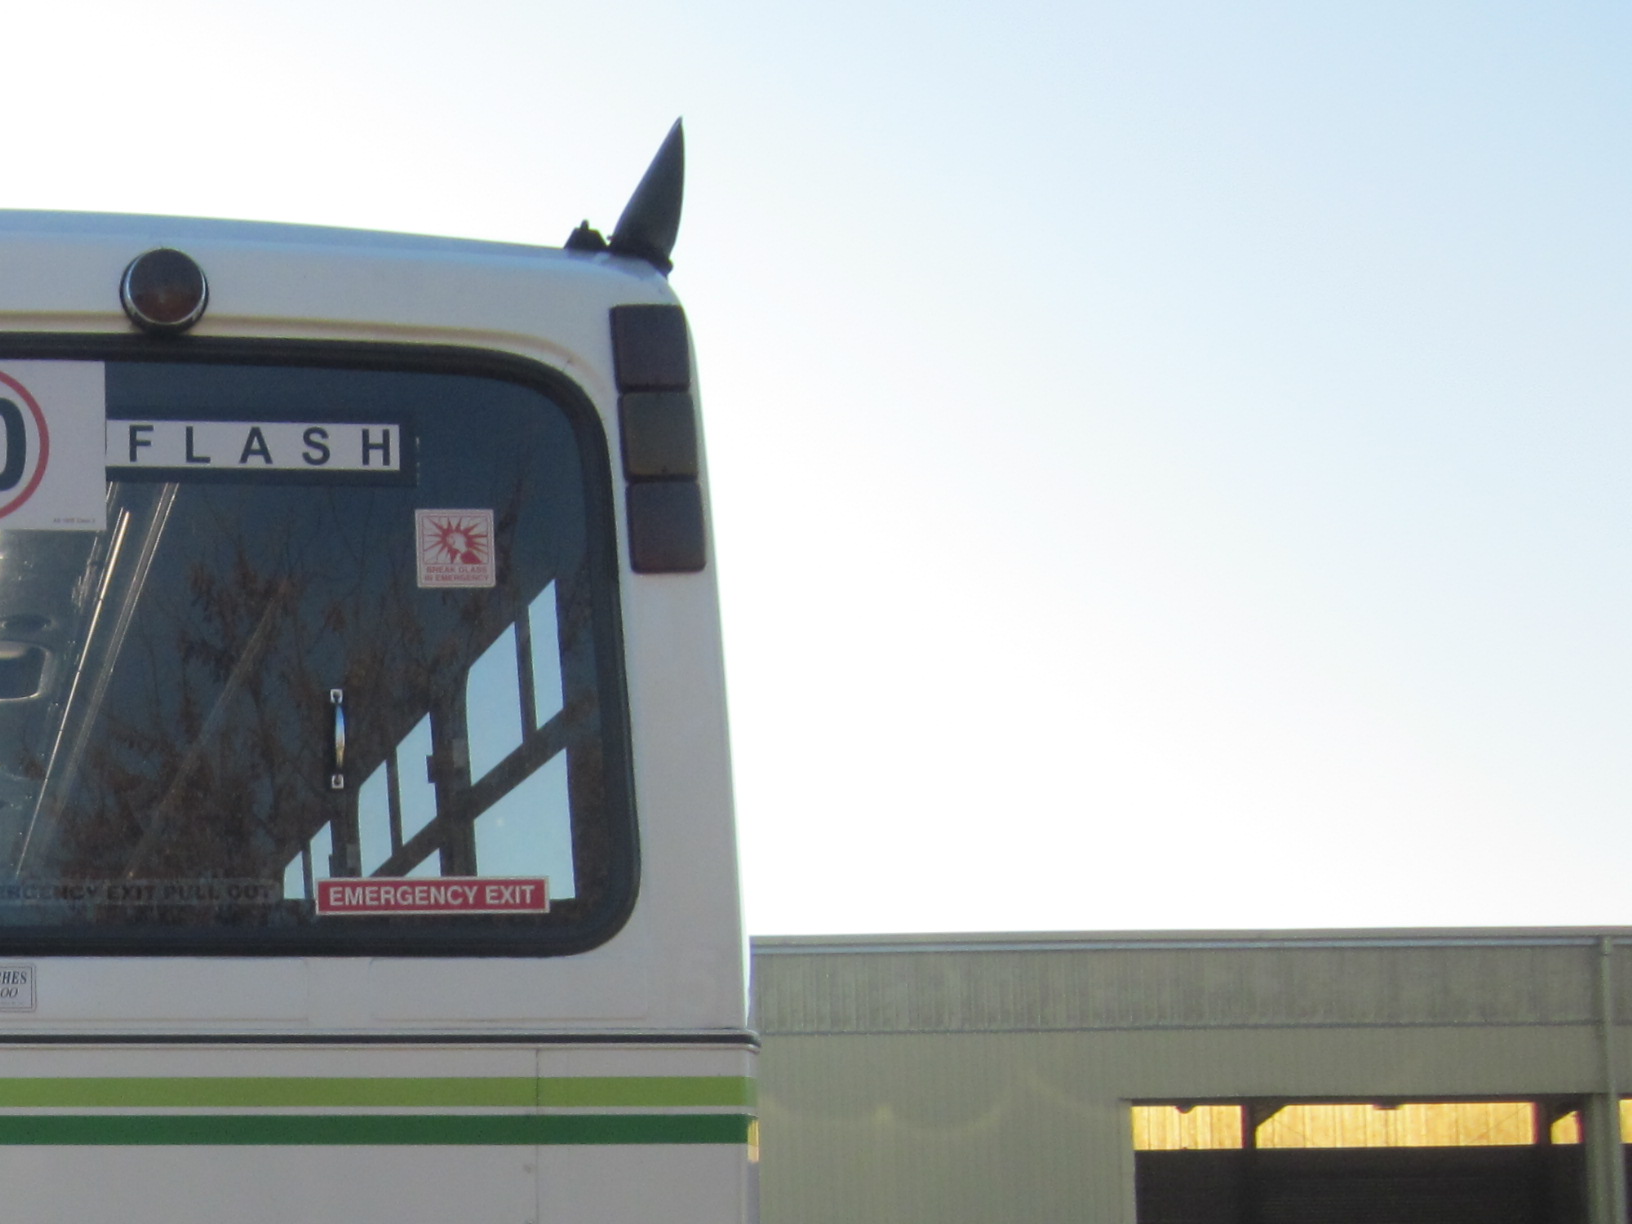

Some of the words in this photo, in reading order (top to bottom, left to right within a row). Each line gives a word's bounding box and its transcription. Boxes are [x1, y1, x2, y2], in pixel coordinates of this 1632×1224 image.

[128, 424, 391, 467] FLASH
[328, 885, 478, 906] EMERGENCY
[484, 884, 536, 905] EXIT
